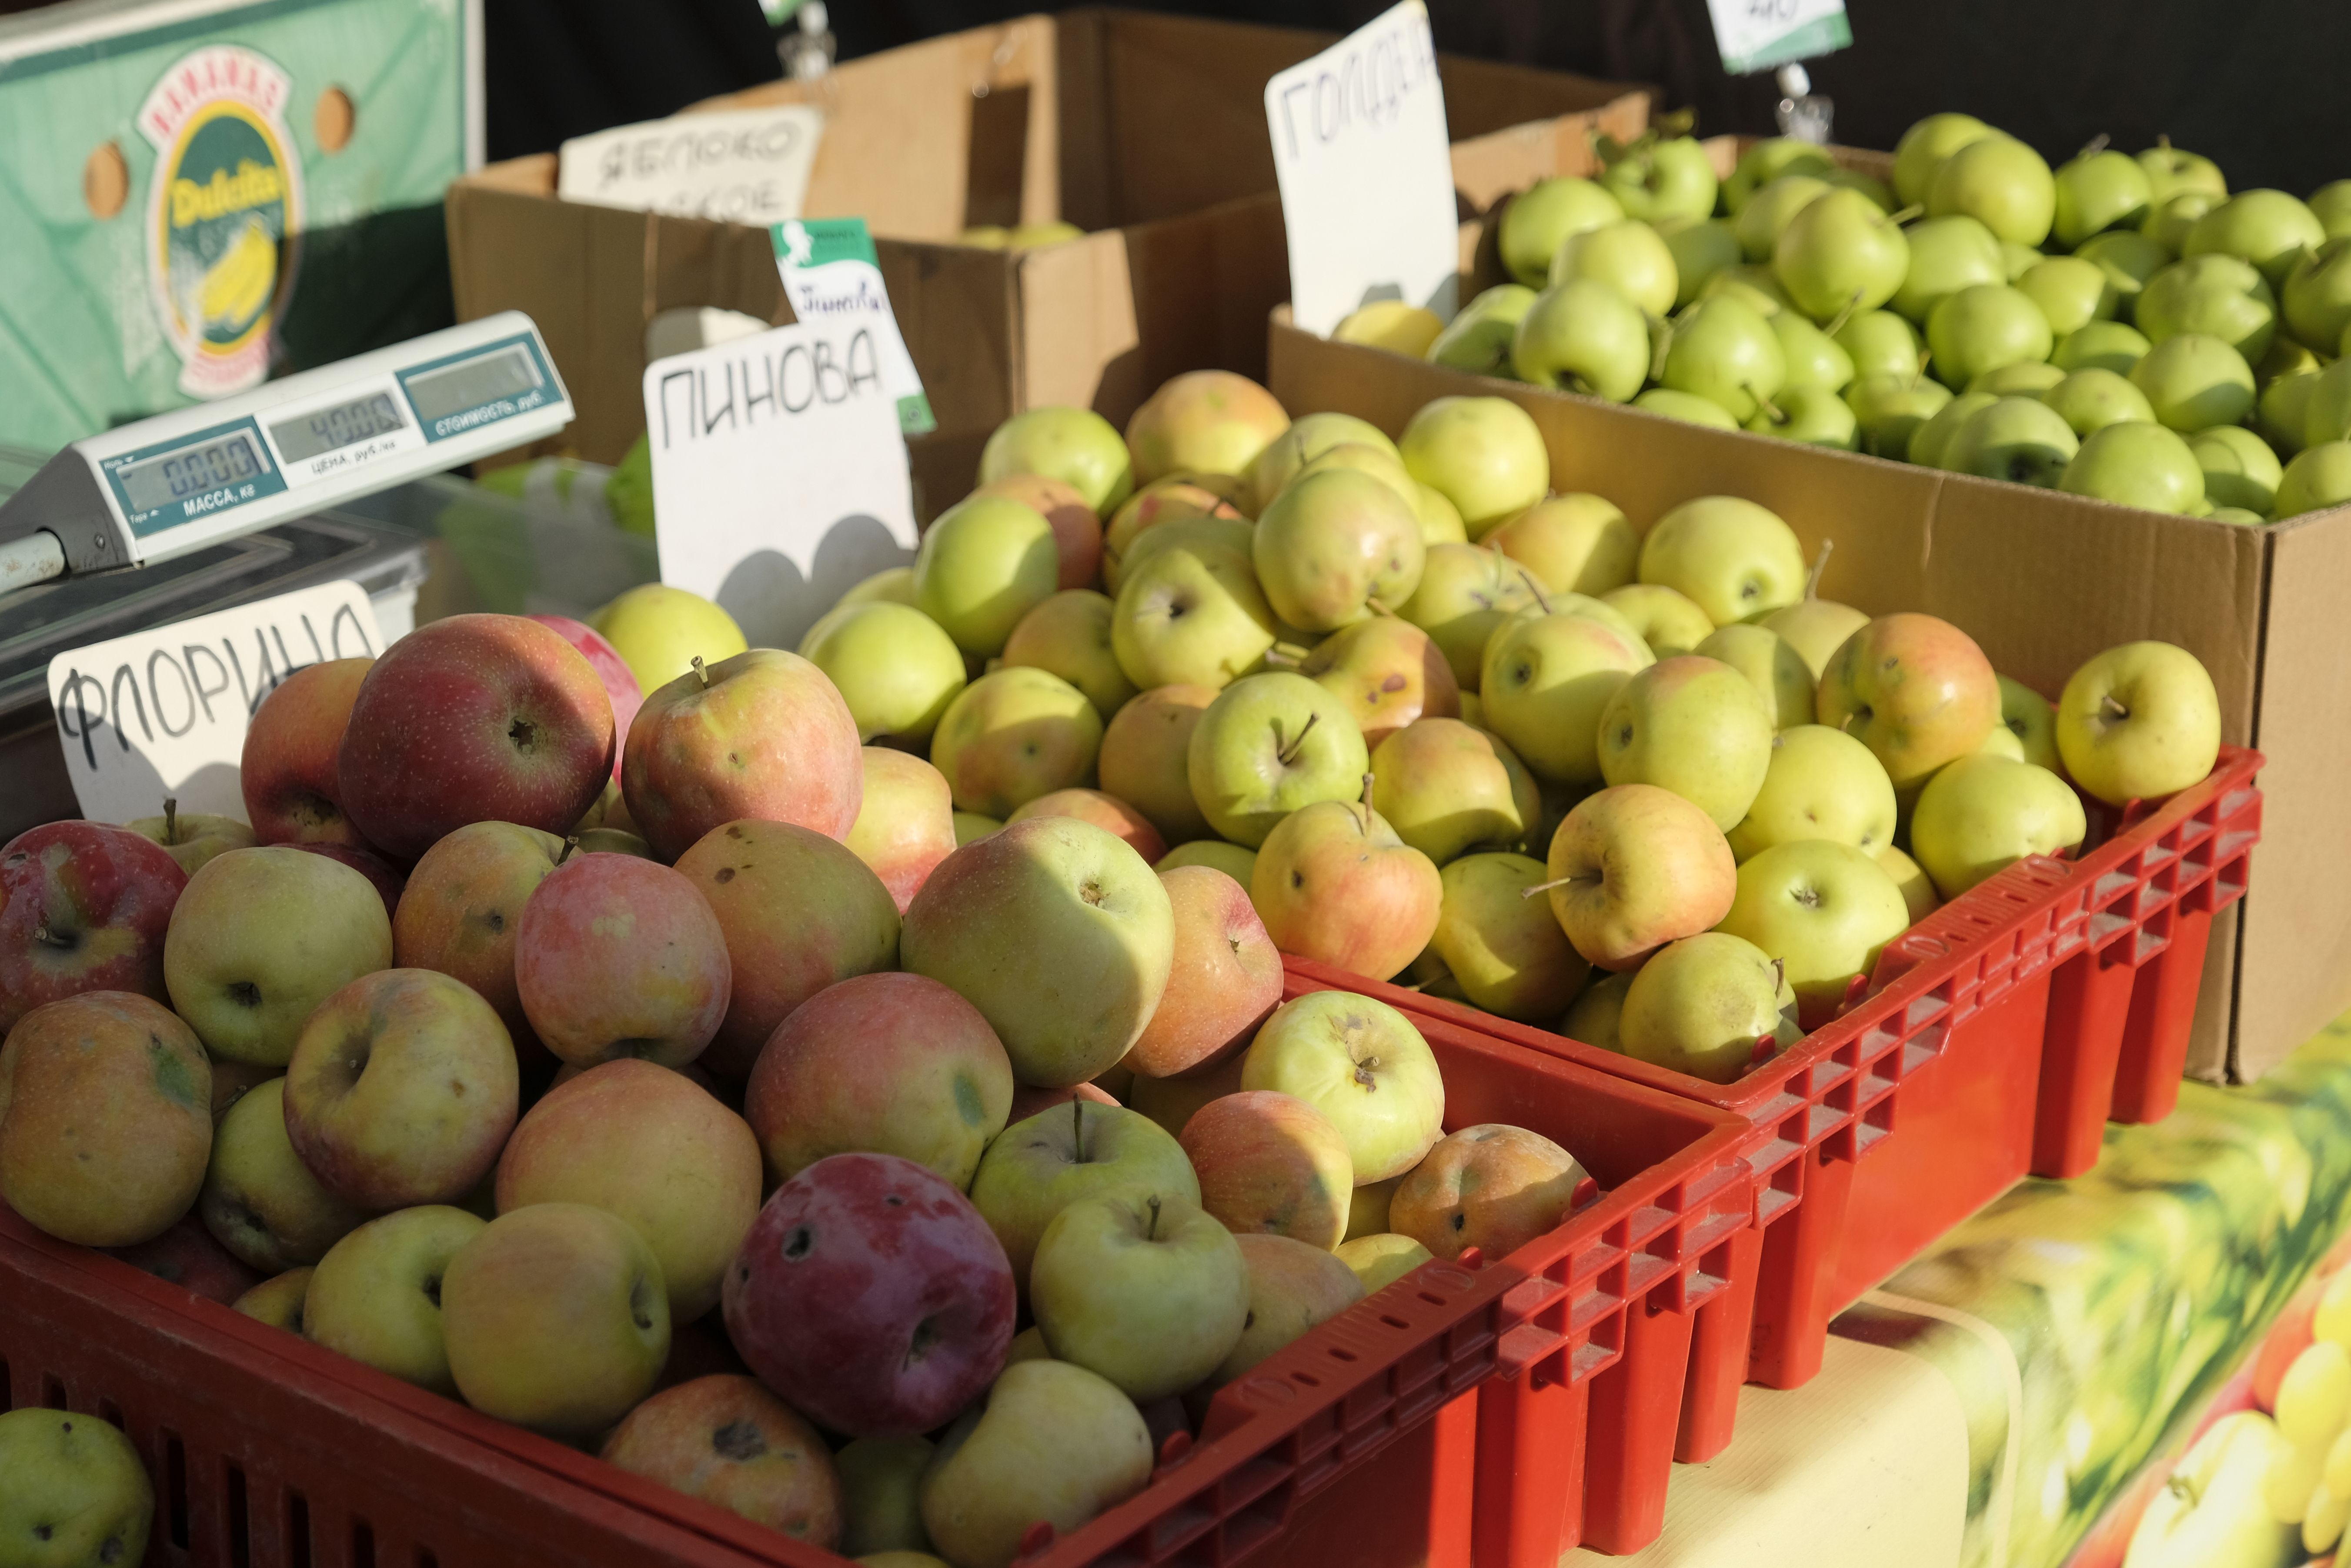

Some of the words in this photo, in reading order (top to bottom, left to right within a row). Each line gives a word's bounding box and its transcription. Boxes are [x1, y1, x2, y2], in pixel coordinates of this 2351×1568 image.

[598, 120, 803, 190] ЯБЛОКО
[660, 327, 882, 449] ПИНОВА
[129, 511, 148, 525] Тара
[183, 487, 238, 517] МАССА,
[58, 603, 375, 771] ФЛОРИНА
